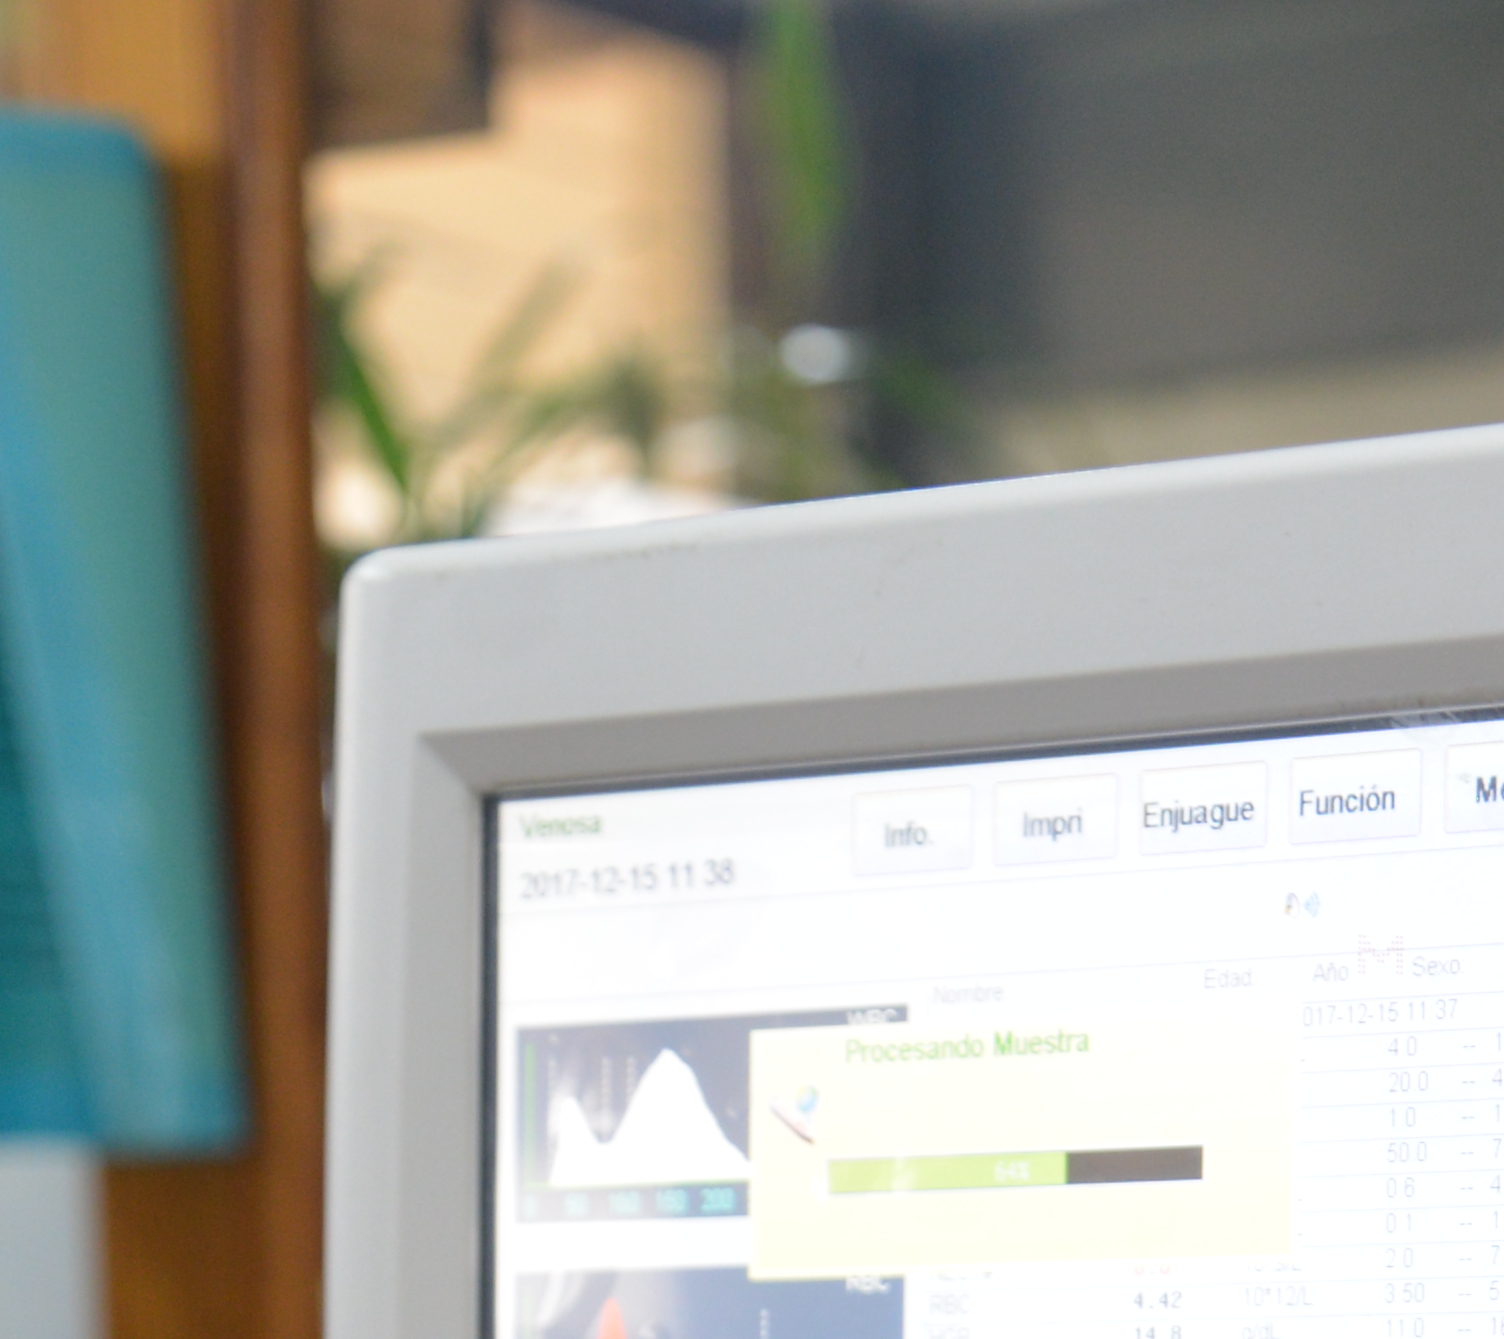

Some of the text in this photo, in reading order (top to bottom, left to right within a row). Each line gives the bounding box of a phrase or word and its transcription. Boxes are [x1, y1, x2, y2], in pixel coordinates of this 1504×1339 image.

[1144, 802, 1254, 833] Enjuague
[1298, 786, 1396, 818] Función
[519, 863, 657, 900] 2017-12-15
[1302, 1001, 1398, 1027] 017-12-15
[844, 1026, 1090, 1062] Procesando Muestra
[1134, 1292, 1182, 1309] 4.42
